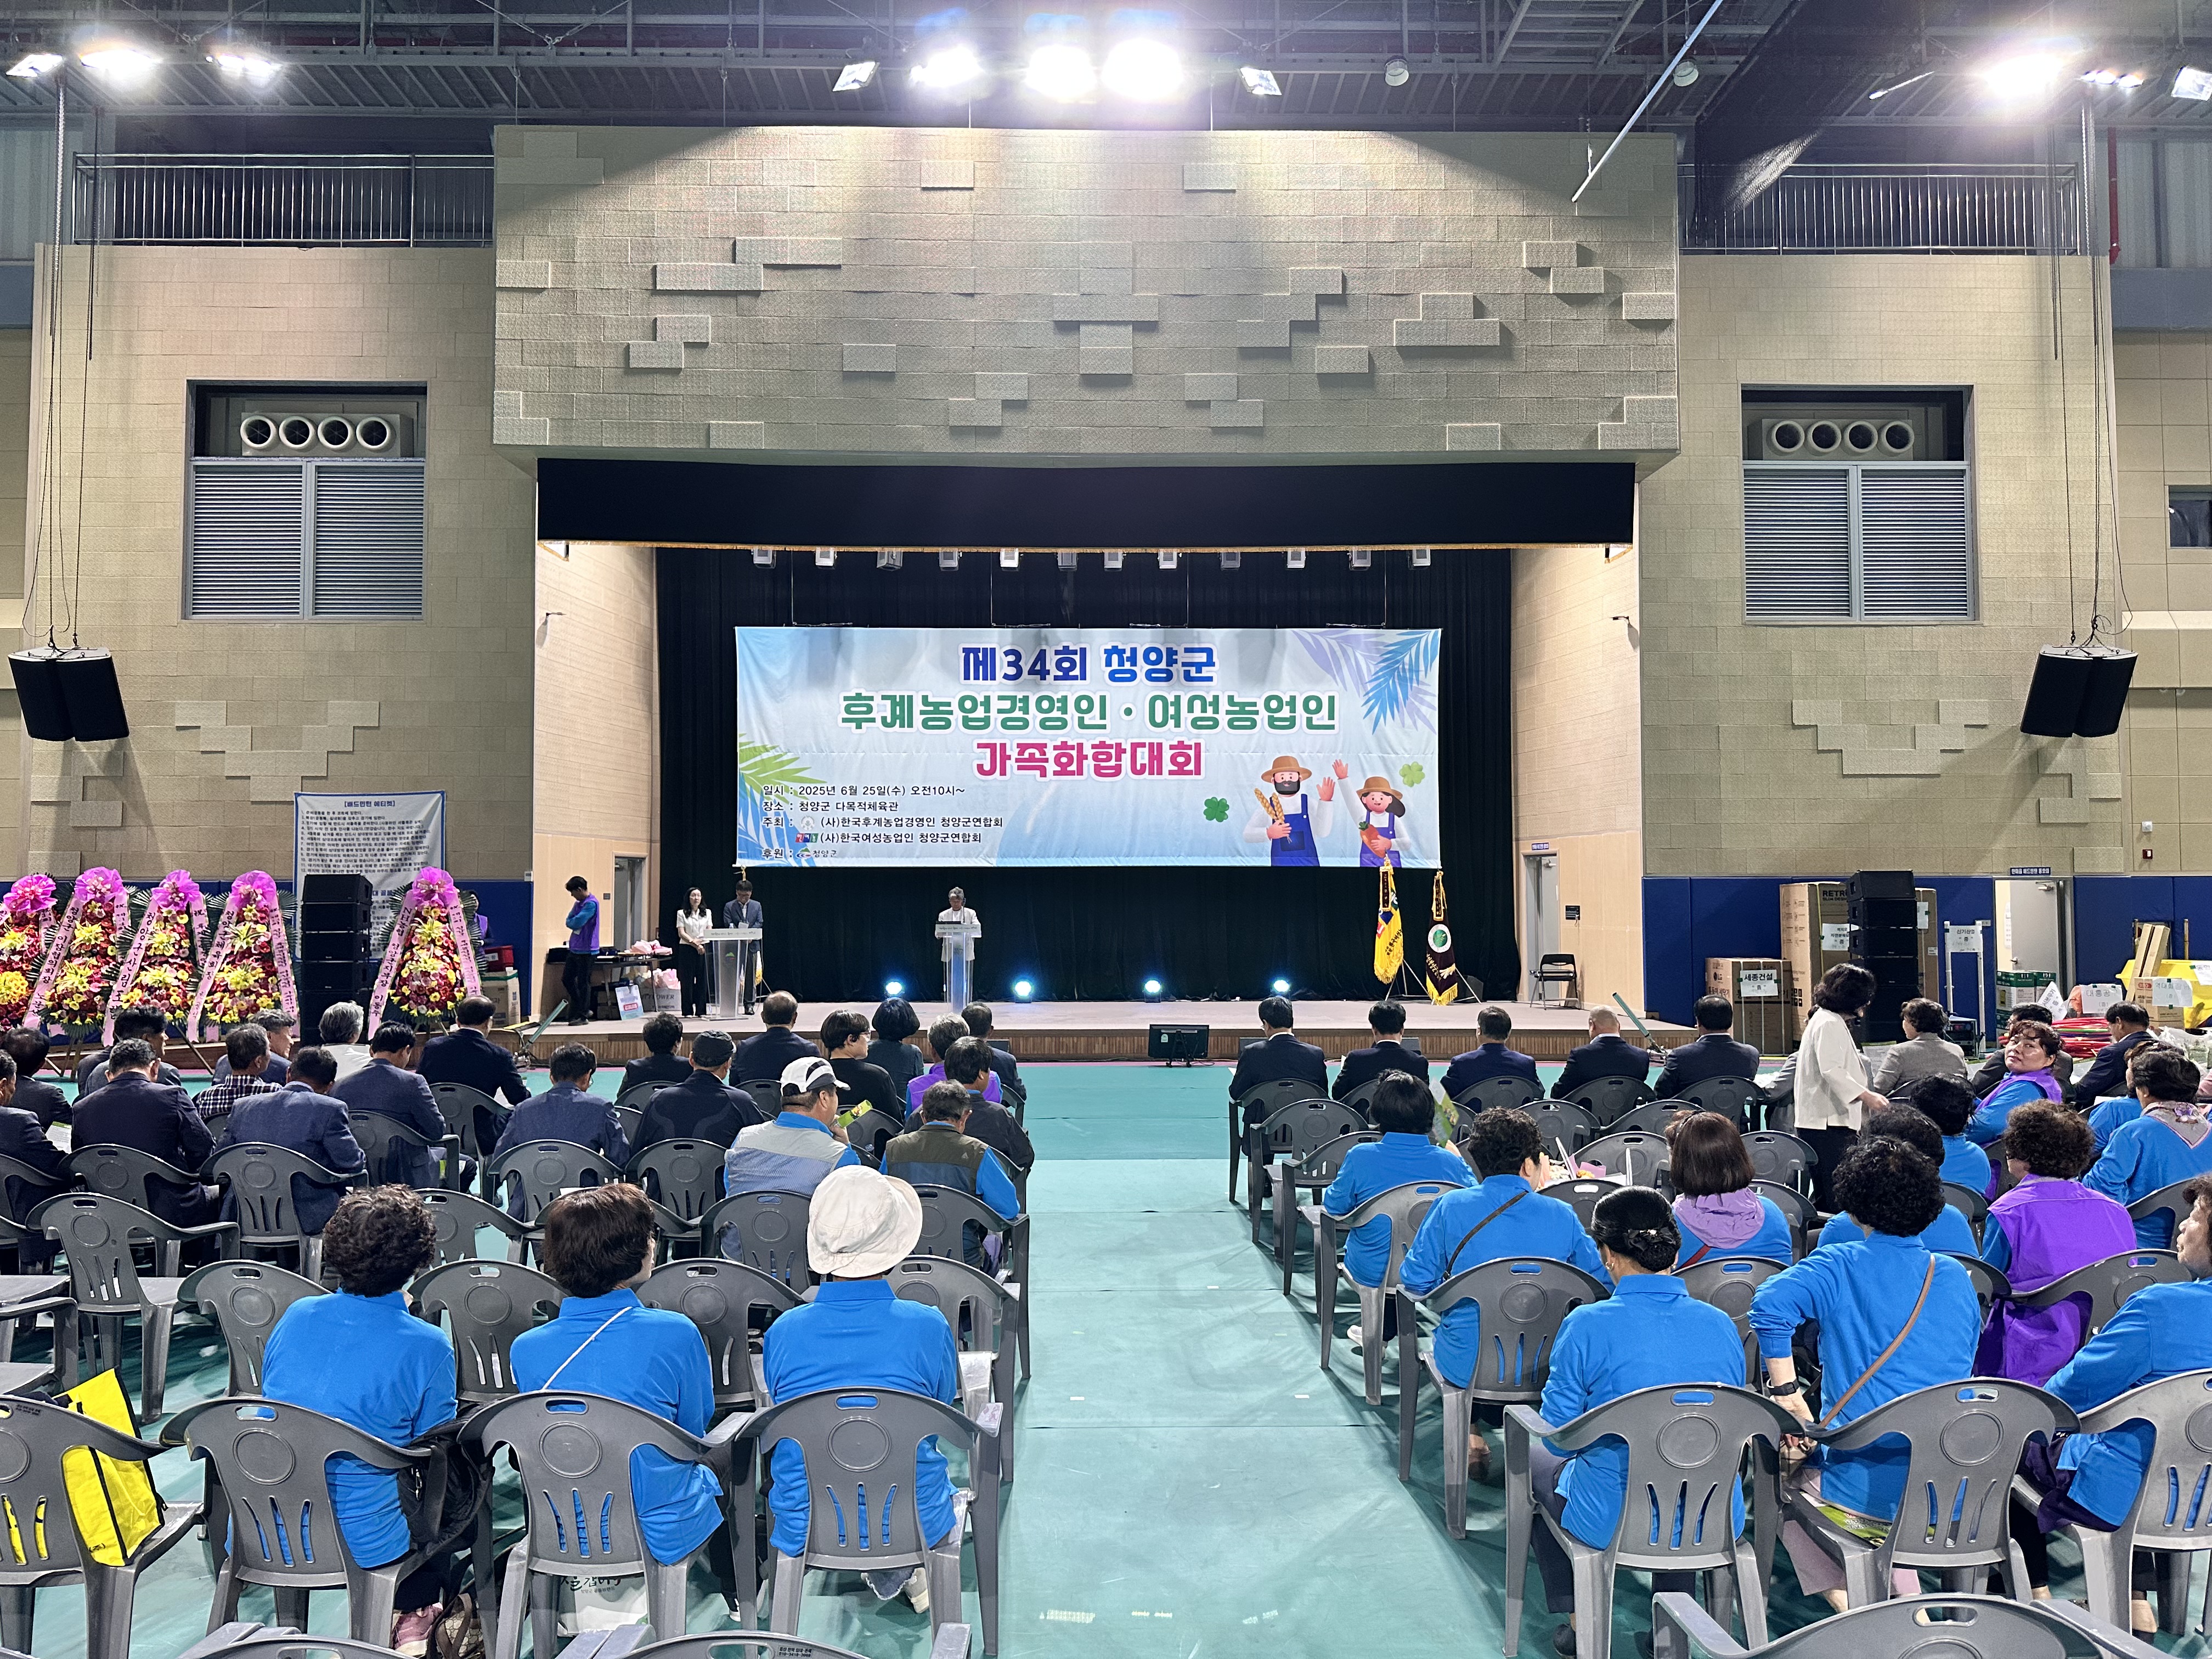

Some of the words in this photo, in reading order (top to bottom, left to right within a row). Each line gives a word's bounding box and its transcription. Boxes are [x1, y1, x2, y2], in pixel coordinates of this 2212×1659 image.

[963, 646, 1087, 681] 제34회
[1104, 645, 1215, 682] 청양군
[842, 693, 1107, 730] 후계농업경영인
[1149, 695, 1335, 730] 여성농업인
[977, 741, 1201, 777] 가족화합대회
[763, 786, 783, 795] 일시
[799, 786, 835, 795] 2025년
[841, 785, 857, 795] 6월
[862, 786, 905, 796] 25일(수)
[911, 786, 965, 795] 오전10시~
[763, 801, 783, 811] 장소
[799, 801, 830, 811] 청양군
[836, 802, 899, 811] 다목적체육관
[763, 817, 783, 827] 주최
[821, 817, 935, 828] (사)한국후계농업경영인
[941, 817, 1002, 827] 청양군연합회
[820, 833, 913, 843] (사)한국여성농업인
[919, 833, 981, 843] 청양군연합회
[762, 849, 783, 859] 후원
[812, 849, 838, 858] 청양군
[63, 907, 79, 932] 청양군
